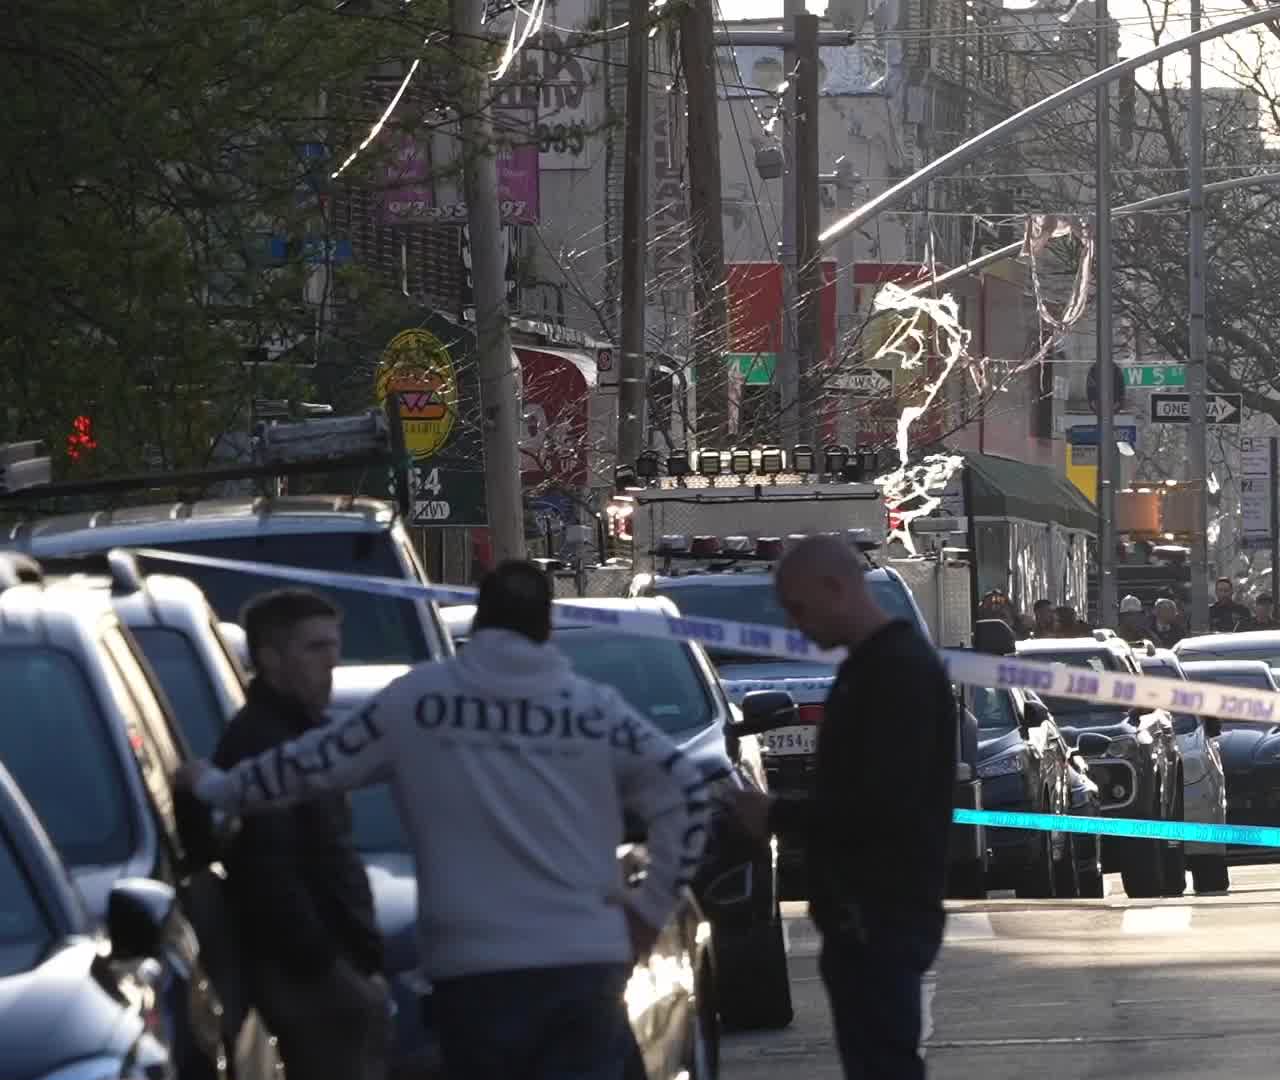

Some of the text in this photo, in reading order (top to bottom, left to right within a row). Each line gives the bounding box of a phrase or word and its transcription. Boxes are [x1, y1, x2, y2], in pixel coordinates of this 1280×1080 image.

[1127, 367, 1143, 385] W
[1152, 367, 1166, 385] 5
[1162, 402, 1188, 415] ONE
[996, 663, 1275, 719] POLICE LINE DO NOT CROSS
[768, 735, 802, 748] 5754
